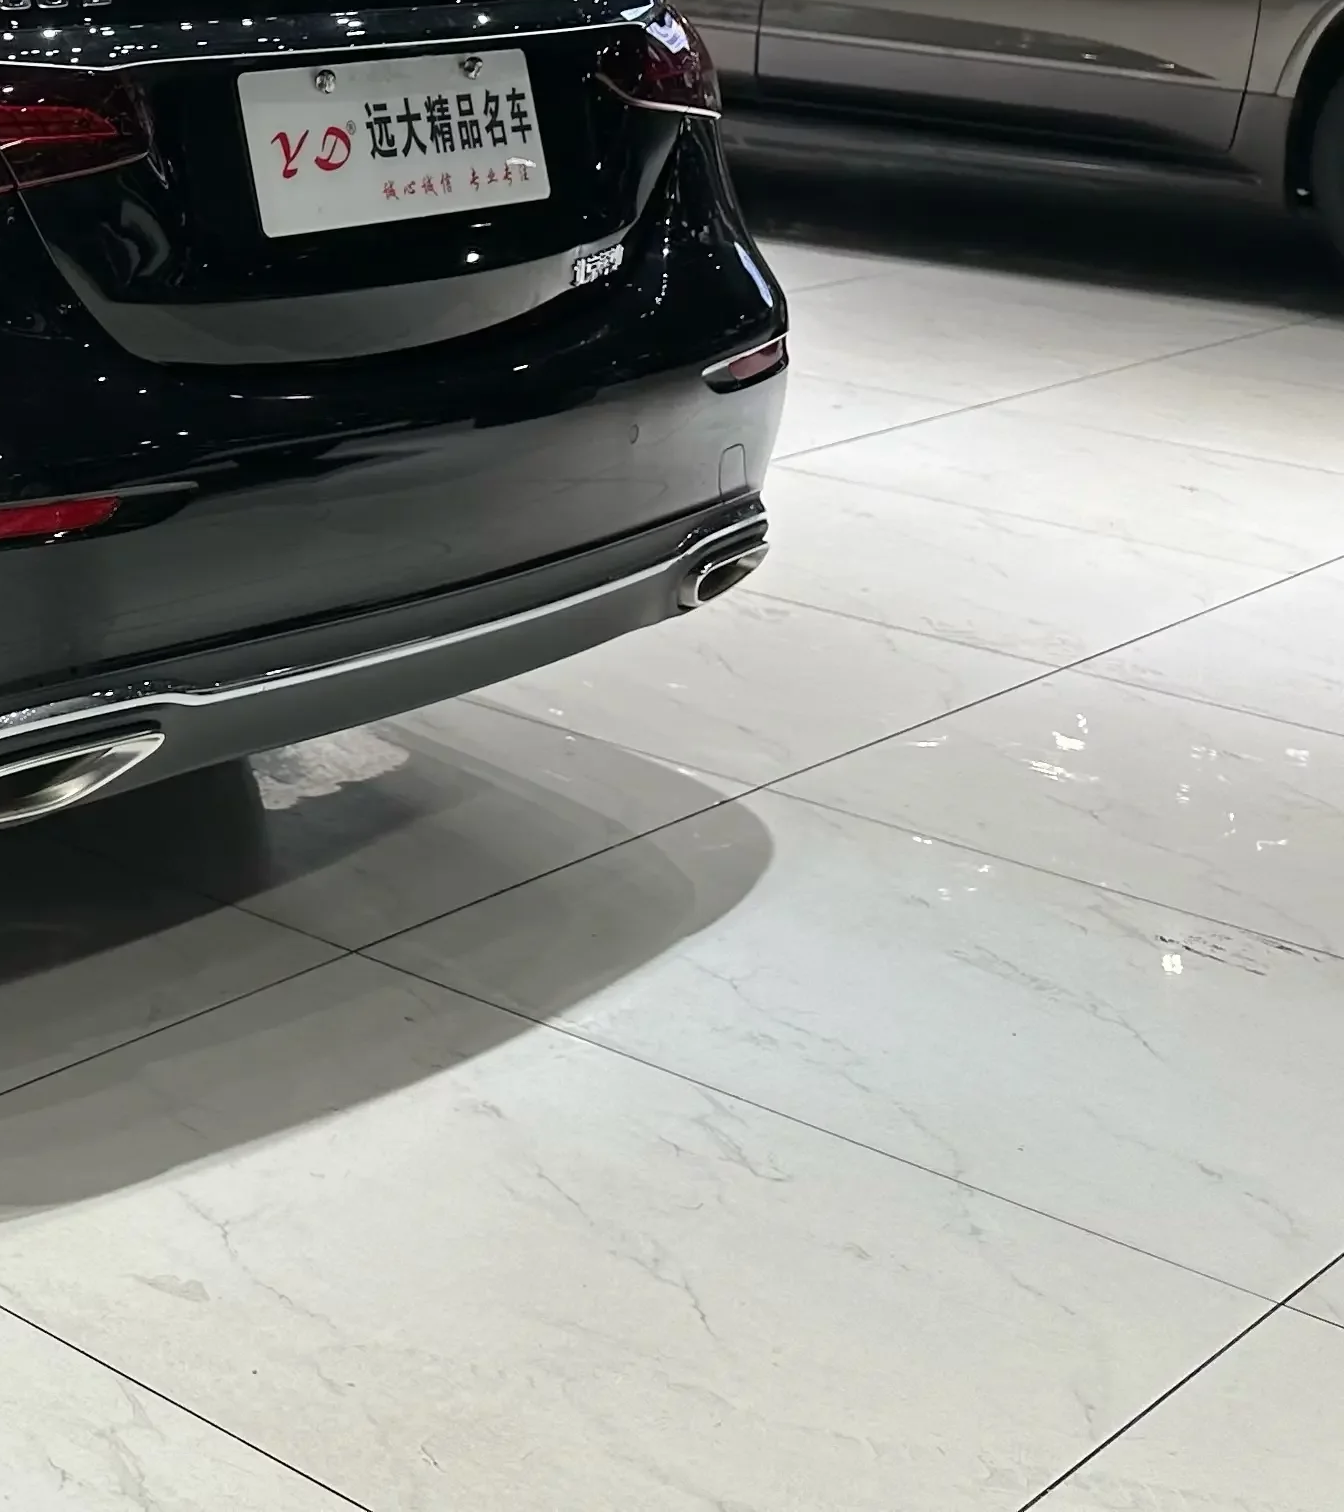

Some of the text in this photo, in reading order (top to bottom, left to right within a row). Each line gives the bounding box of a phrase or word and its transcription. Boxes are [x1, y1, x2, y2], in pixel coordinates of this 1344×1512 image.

[365, 87, 532, 159] 远大精品名车
